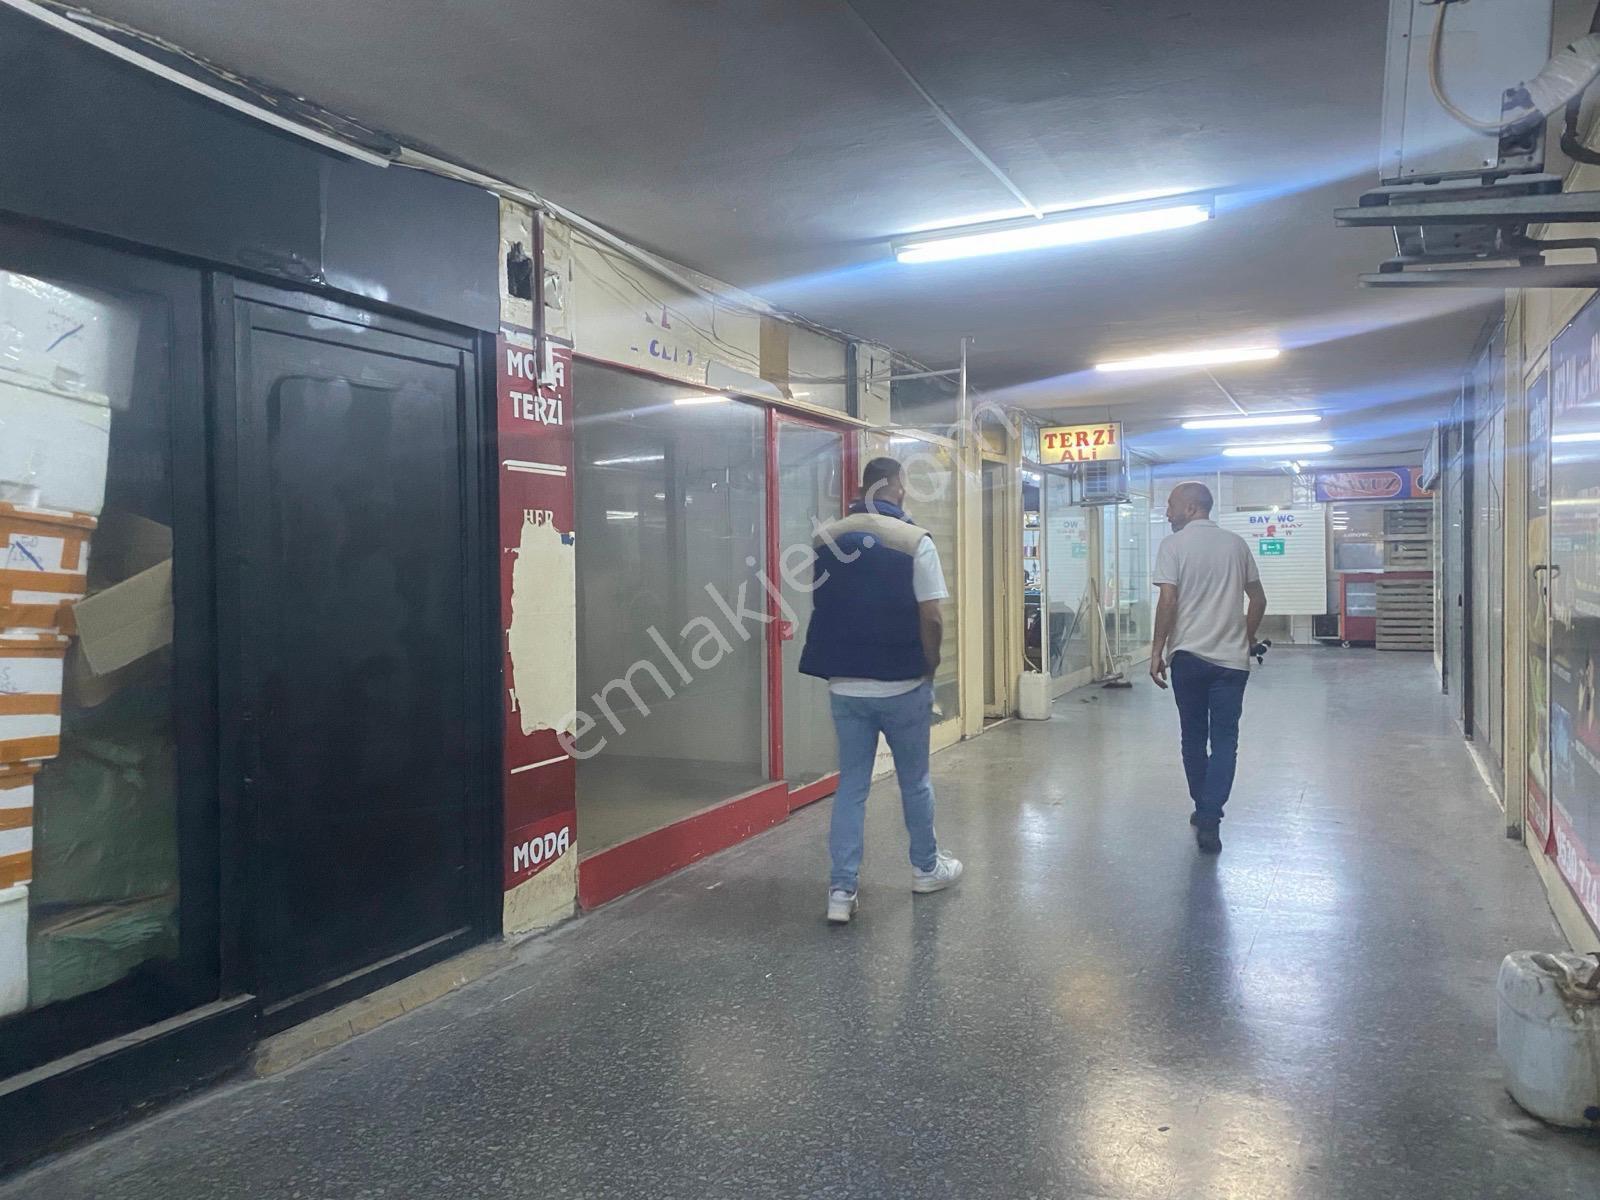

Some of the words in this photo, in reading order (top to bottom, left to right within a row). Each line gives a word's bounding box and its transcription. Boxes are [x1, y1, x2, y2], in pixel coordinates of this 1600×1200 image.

[507, 349, 565, 388] MOA
[510, 391, 564, 426] TERZİ
[1044, 424, 1116, 449] TERZİ
[1249, 516, 1270, 524] BAY
[1277, 514, 1295, 522] WC
[513, 826, 568, 873] MODA
